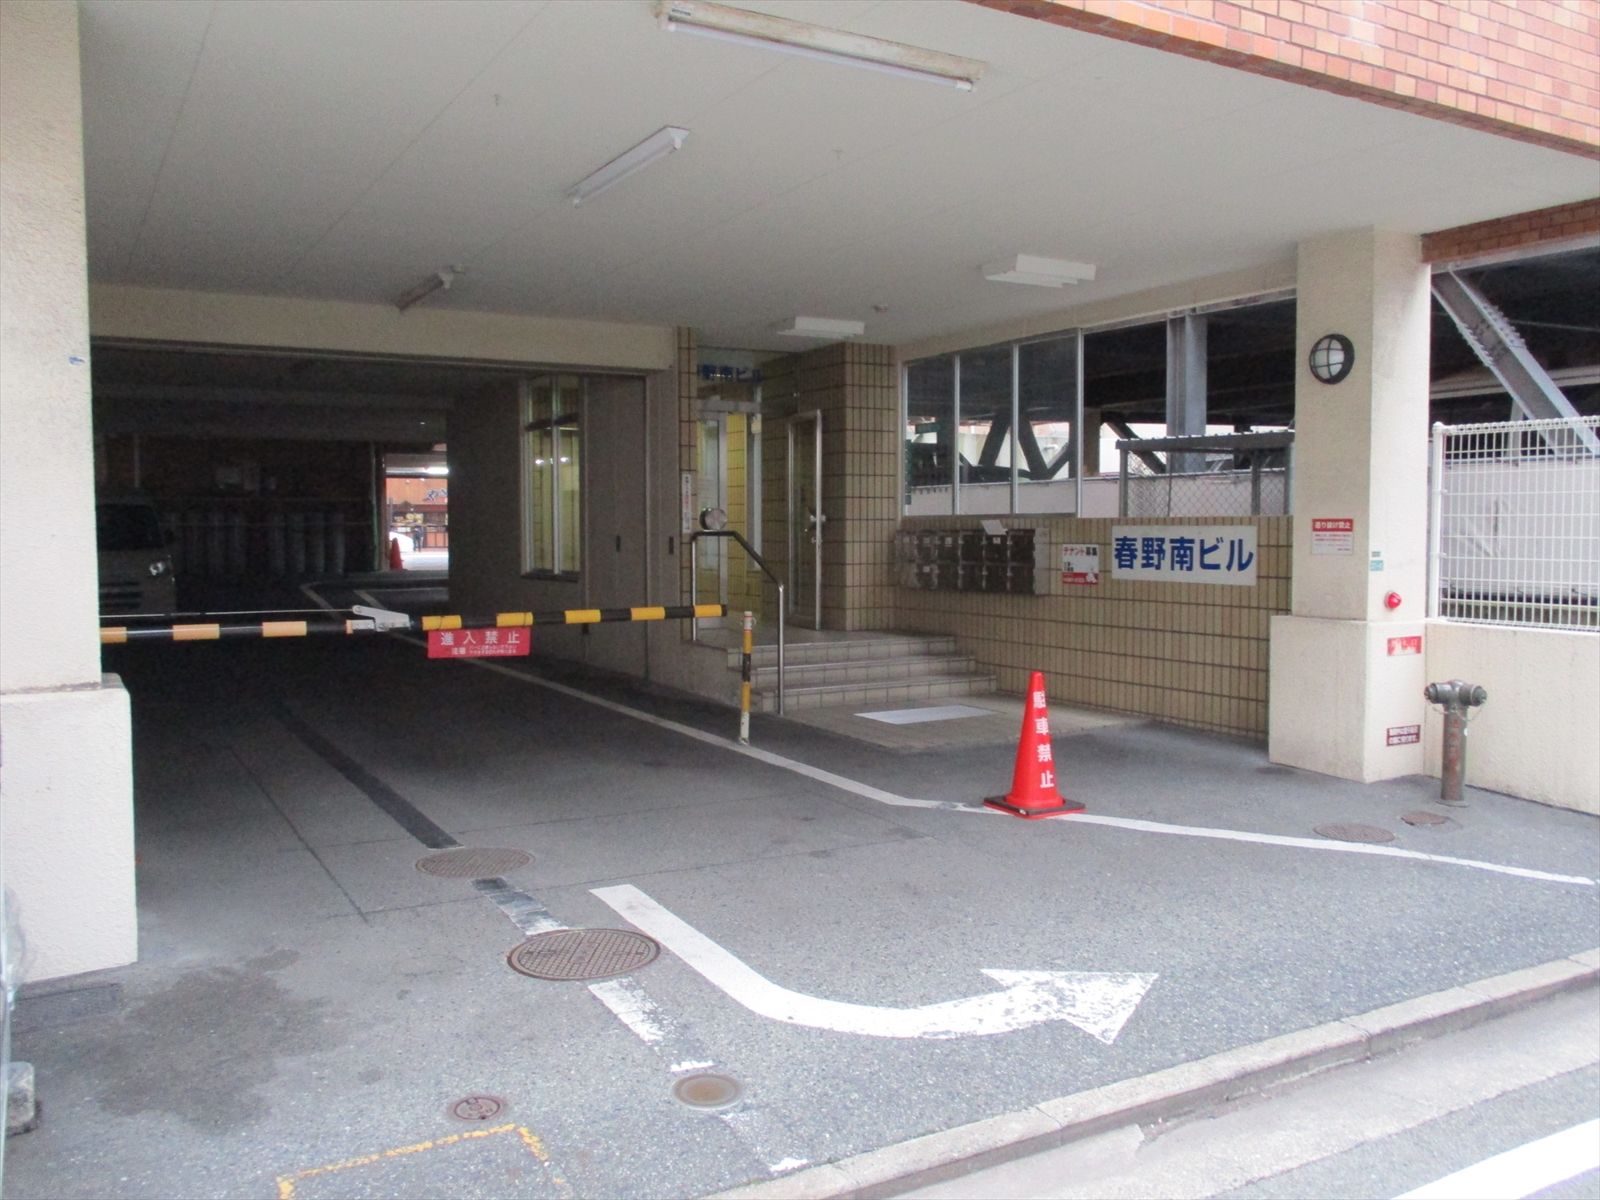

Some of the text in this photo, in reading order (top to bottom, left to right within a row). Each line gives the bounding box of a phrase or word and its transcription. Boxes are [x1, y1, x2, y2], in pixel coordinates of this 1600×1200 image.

[1114, 536, 1254, 572] 春野南ビル
[440, 630, 520, 646] 進入禁止
[1033, 691, 1055, 788] 駐車禁止
